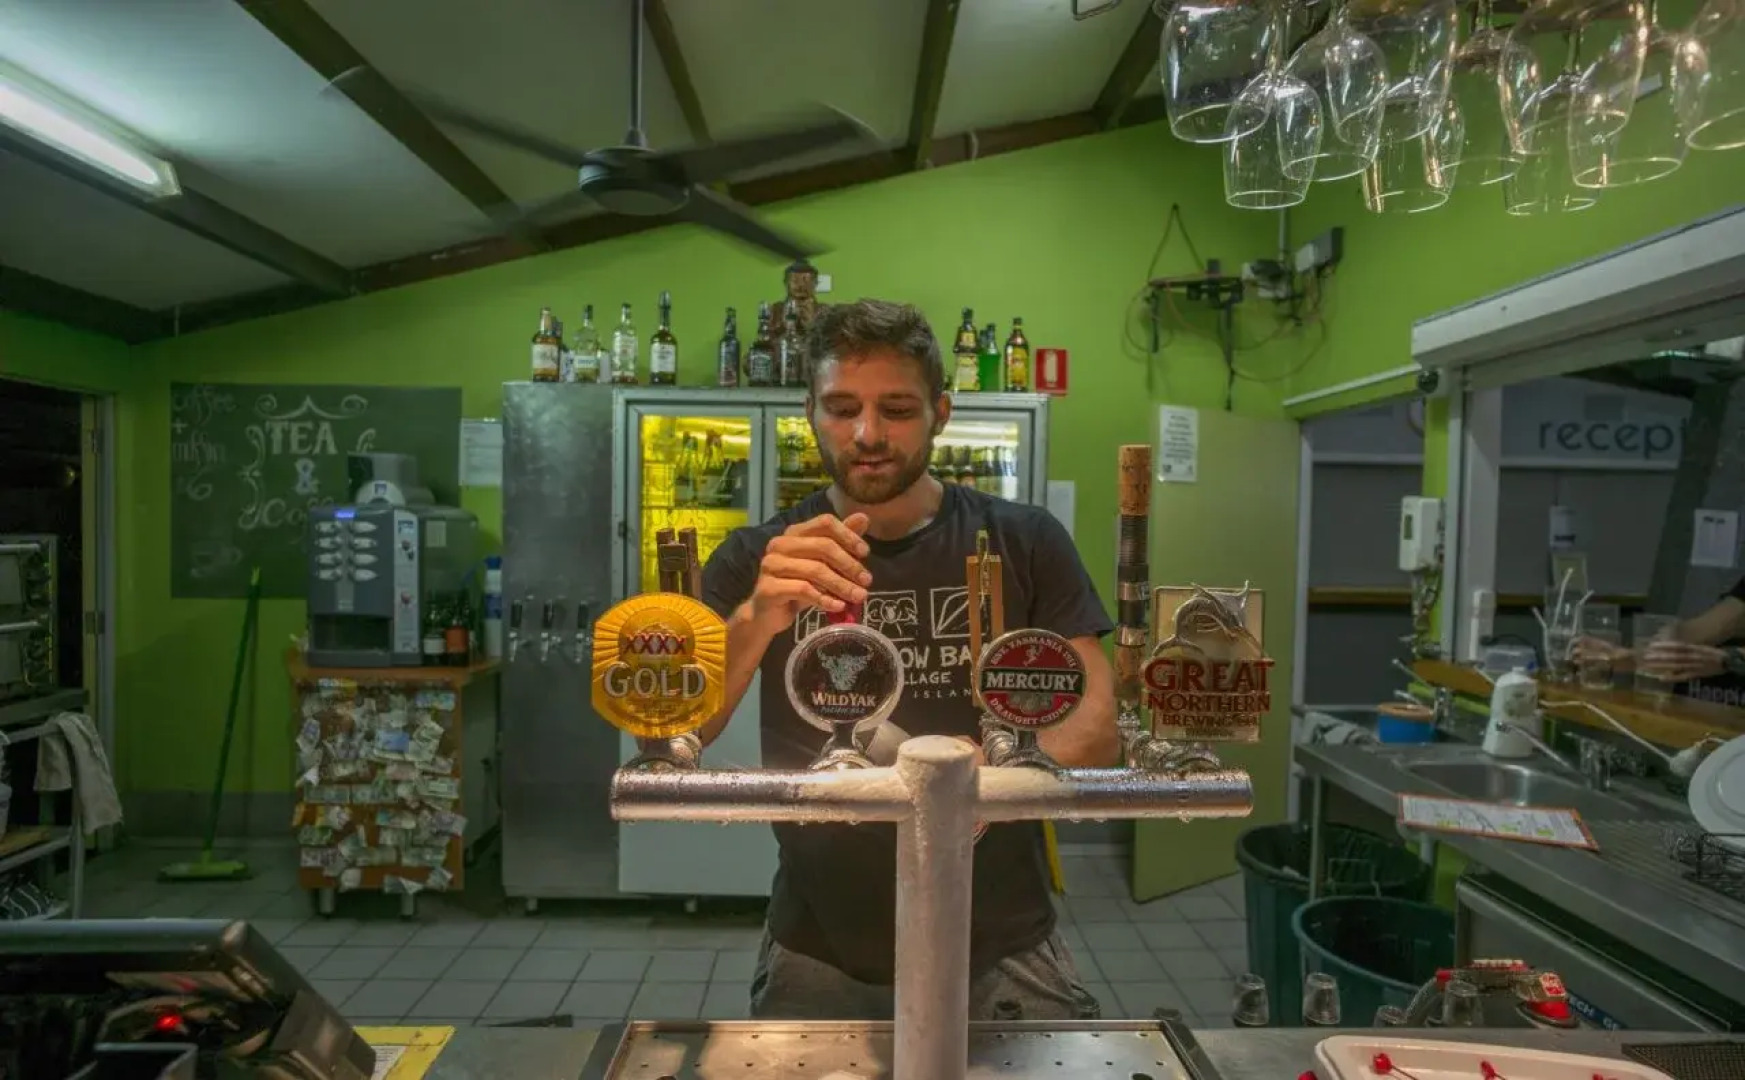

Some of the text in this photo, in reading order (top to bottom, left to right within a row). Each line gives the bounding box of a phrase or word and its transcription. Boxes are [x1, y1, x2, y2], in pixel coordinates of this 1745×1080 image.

[265, 420, 339, 455] TEA
[291, 457, 321, 496] &
[623, 632, 688, 655] XXXX
[604, 661, 706, 700] GOLD
[986, 672, 1079, 691] MERCURY
[1145, 659, 1275, 691] GREAT
[913, 688, 972, 699] ISLAN
[1147, 693, 1271, 712] NORTHERN
